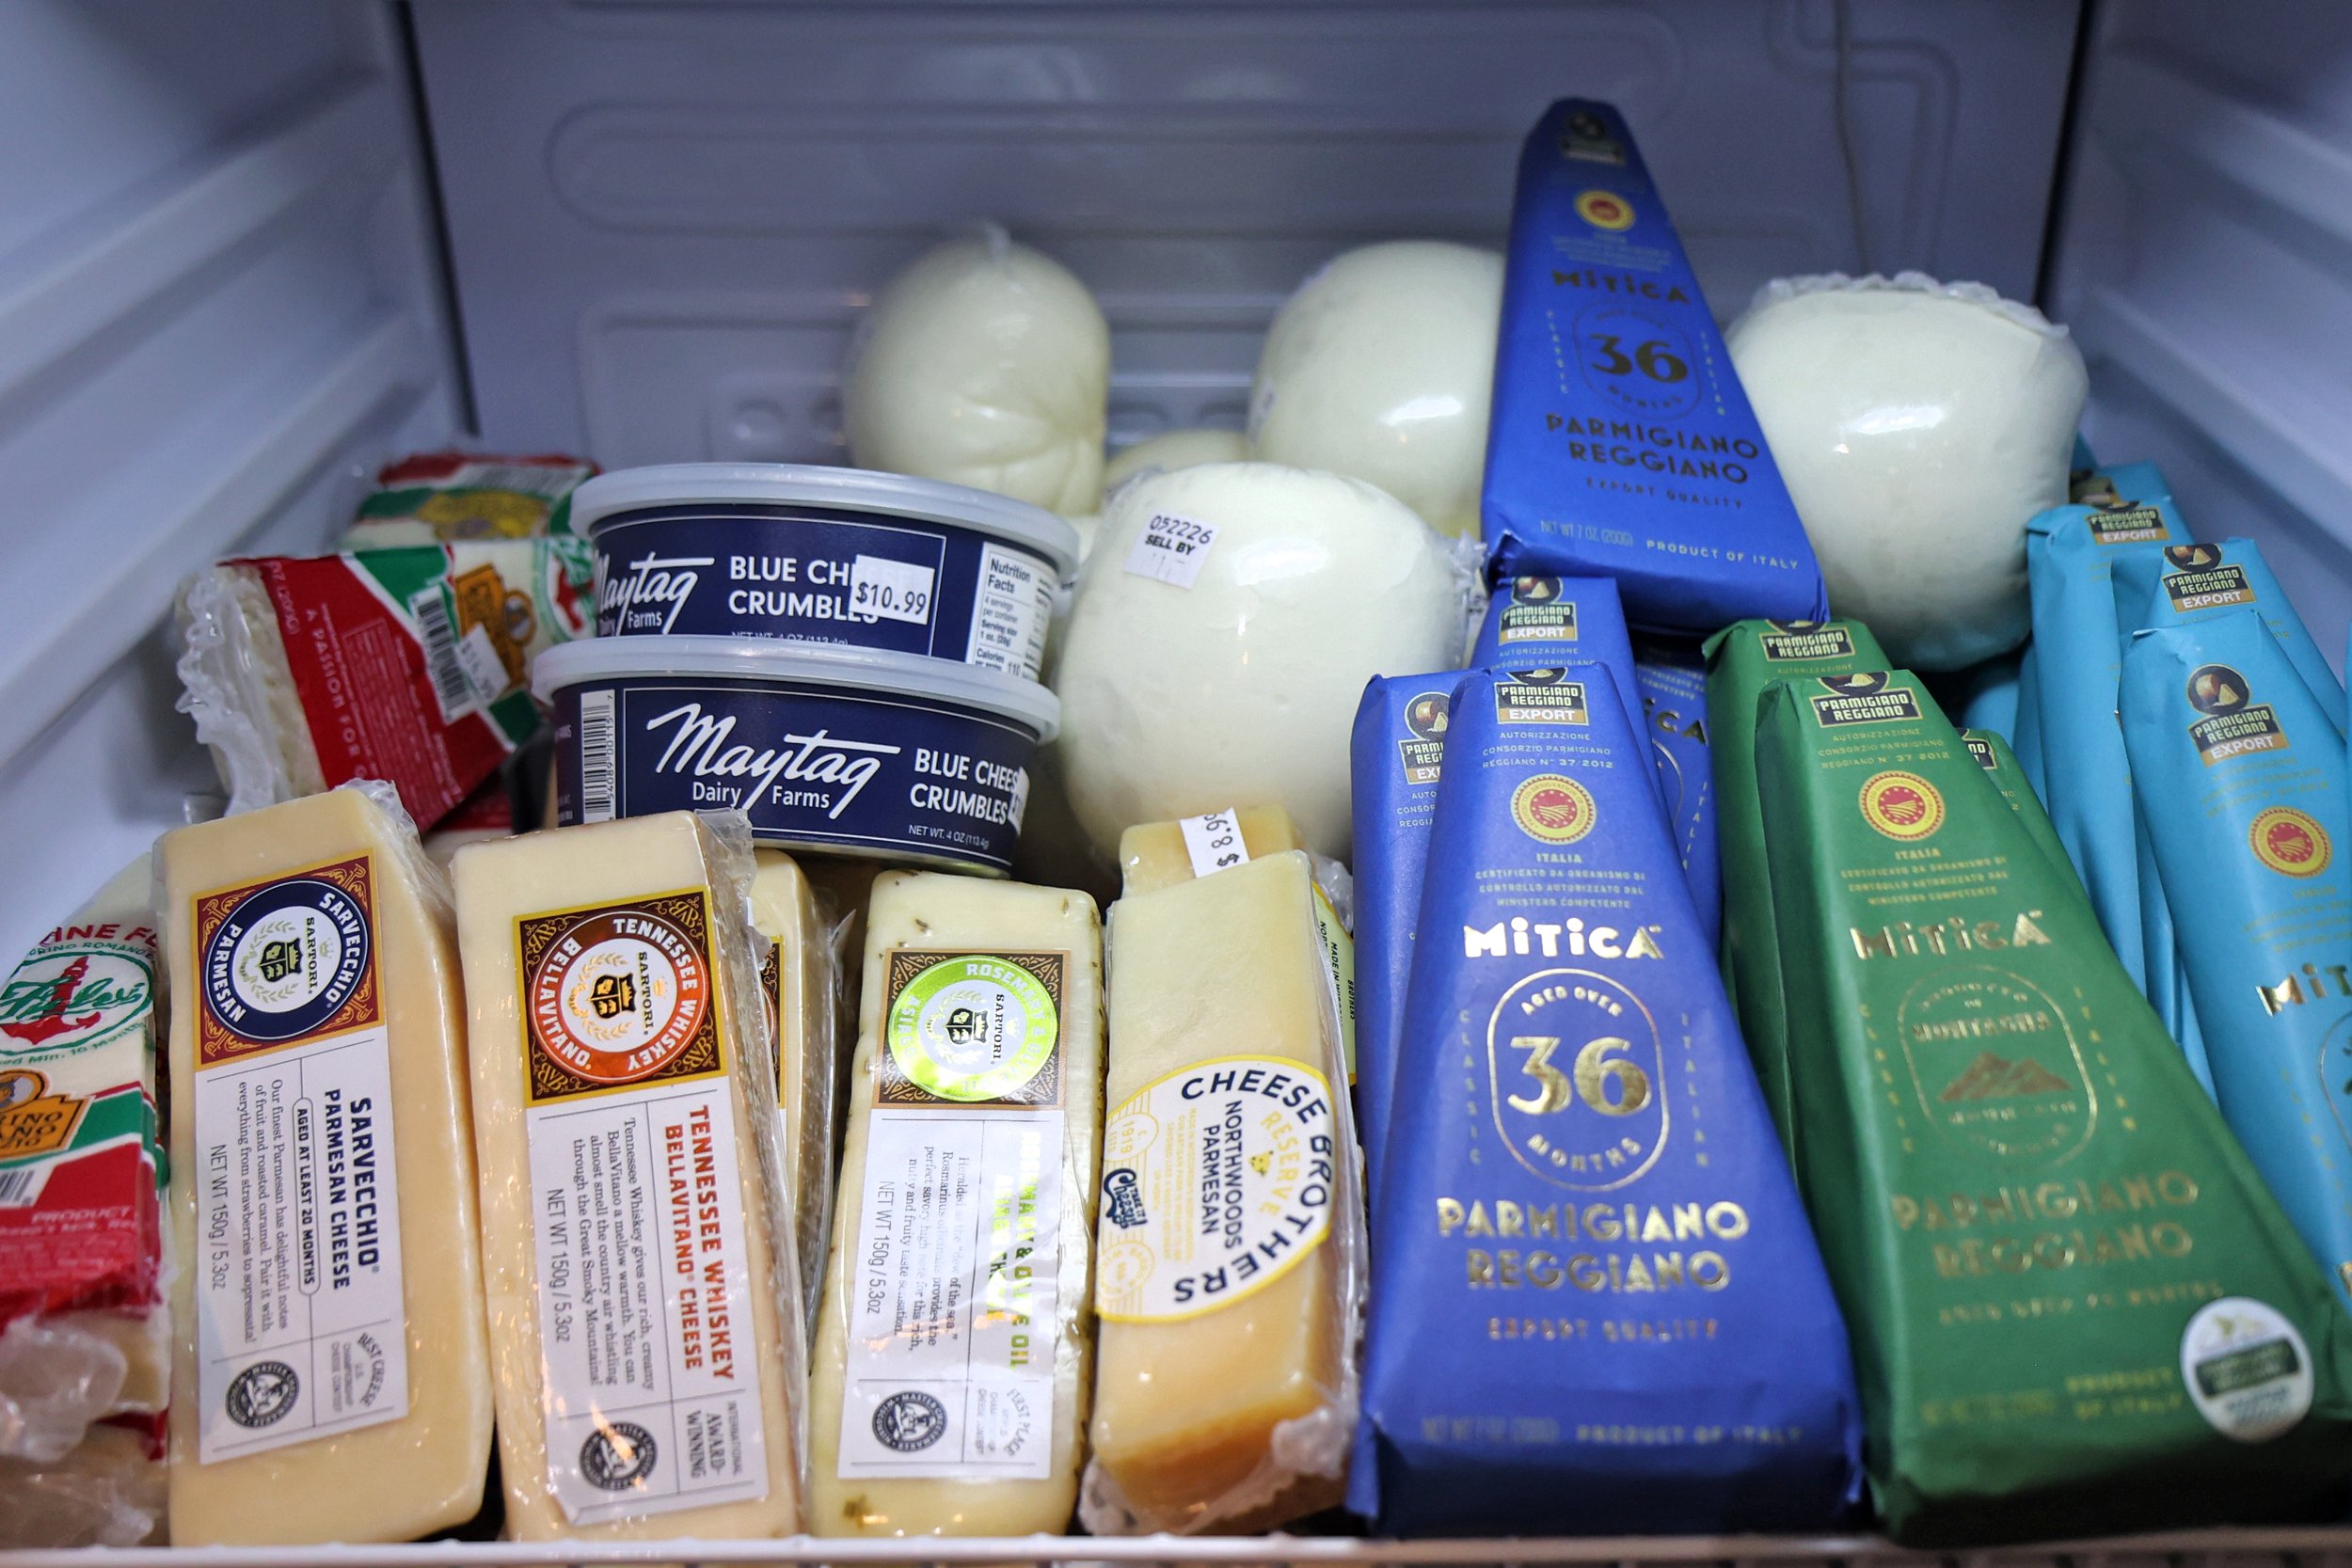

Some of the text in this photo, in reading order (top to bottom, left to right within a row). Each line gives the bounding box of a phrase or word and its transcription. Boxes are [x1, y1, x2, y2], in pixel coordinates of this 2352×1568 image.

[1590, 333, 1689, 385] 36
[1546, 412, 1758, 461] PARMIGIANO
[1568, 441, 1748, 485] REGGIANO
[1586, 477, 1743, 510] EXPORT QUALITY
[1145, 533, 1197, 556] SELL BY
[1150, 515, 1214, 545] 052226
[2103, 529, 2158, 543] EXPORT
[729, 556, 798, 582] BLUE
[990, 558, 1031, 582] Nutrition
[1646, 539, 1800, 570] PRODUCT OF ITALY
[988, 574, 1015, 594] Facts
[2169, 569, 2240, 590] PARMIGIANO
[2180, 578, 2237, 595] REGGIANO
[728, 590, 880, 625] CRUMBL
[855, 581, 928, 617] $10.99
[2182, 590, 2243, 610] EXPORT
[628, 610, 663, 629] Farms
[1507, 626, 1565, 640] EXPORT
[1509, 615, 1564, 626] REGGIANO
[977, 647, 1005, 662] Calories
[1767, 631, 1844, 650] PARMIGIANO
[1777, 643, 1839, 658] REGGIANO
[1502, 686, 1579, 697] PARMIGIANO
[1511, 696, 1572, 706] REGGIANO
[1820, 693, 1910, 711] PARMIGIANO
[1509, 708, 1575, 721] EXPORT
[1833, 705, 1905, 721] REGGIANO
[2195, 710, 2271, 738] PARMIGIANO
[1482, 744, 1612, 756] CONSORZIO PARMIGIANO
[1500, 731, 1591, 741] AUTORIZZAZIONE
[1833, 728, 1922, 742] AUTORIZZAZIONE
[2207, 721, 2268, 744] REGGIANO
[2211, 736, 2274, 760] EXPORT
[646, 703, 901, 819] Maytag
[914, 748, 1019, 795] BLUE CHEES
[1482, 758, 1536, 769] REGGIANO
[606, 762, 615, 800] 54089
[692, 782, 831, 812] Dairy Farms
[910, 783, 1009, 826] CRUMBLES
[909, 824, 929, 836] NET
[1535, 852, 1583, 863] ITALIA
[1894, 847, 1942, 861] ITALIA
[83, 942, 146, 956] ROMANO
[306, 916, 318, 989] SARTORI
[1330, 942, 1340, 969] MADE
[213, 923, 246, 1023] PARMESAN
[638, 951, 654, 1029] SARTORI
[612, 918, 698, 1071] TENNESSEE WHISKEY
[965, 963, 1047, 1025] ROSEMARY
[1519, 985, 1623, 1019] AGED OVER
[897, 994, 922, 1058] ASIAGO
[993, 993, 1005, 1060] SARTORI
[1507, 1036, 1653, 1117] 36
[256, 1098, 268, 1126] fruit
[256, 1129, 269, 1152] and
[271, 1079, 288, 1228] Our finest Parmesan has
[1120, 1119, 1135, 1155] 1919
[1527, 1132, 1642, 1174] MONTHS
[237, 1081, 254, 1257] everything from strawberries
[257, 1154, 270, 1200] roasted
[1202, 1123, 1220, 1236] PARMESAN
[1224, 1100, 1243, 1250] NORTHWOODS
[1259, 1110, 1300, 1217] RESERVE
[297, 1108, 315, 1285] AGED AT LEAST 20 MONTHS
[325, 1088, 351, 1291] PARMESAN CHEESE
[1172, 1069, 1334, 1304] CHEESE BROTHERS
[1891, 1171, 2199, 1231] PARMIGIANO
[208, 1144, 230, 1291] NET WT 150g 5.3oz
[573, 1138, 596, 1307] through the Great Smoky
[590, 1134, 612, 1296] almost smell the country
[899, 1191, 917, 1247] and fruity
[913, 1146, 937, 1320] perfect savory this
[1436, 1196, 1750, 1243] PARMIGIANO
[624, 1117, 655, 1392] Tennessee Whiskey gives our creamy
[690, 1104, 734, 1380] TENNESSEE WHISKEY
[866, 1180, 895, 1315] NET WT 150g 5.3oz
[930, 1151, 954, 1323] Rosmarinus provides
[1932, 1221, 2193, 1278] REGGIANO
[261, 1258, 273, 1287] Pair
[547, 1188, 574, 1343] NET WT 150g 5.3oz
[608, 1130, 637, 1385] BellaVitano mellow You can
[1467, 1248, 1731, 1294] REGGIANO
[679, 1287, 704, 1371] CHEESE
[1487, 1317, 1590, 1341] EXPORT
